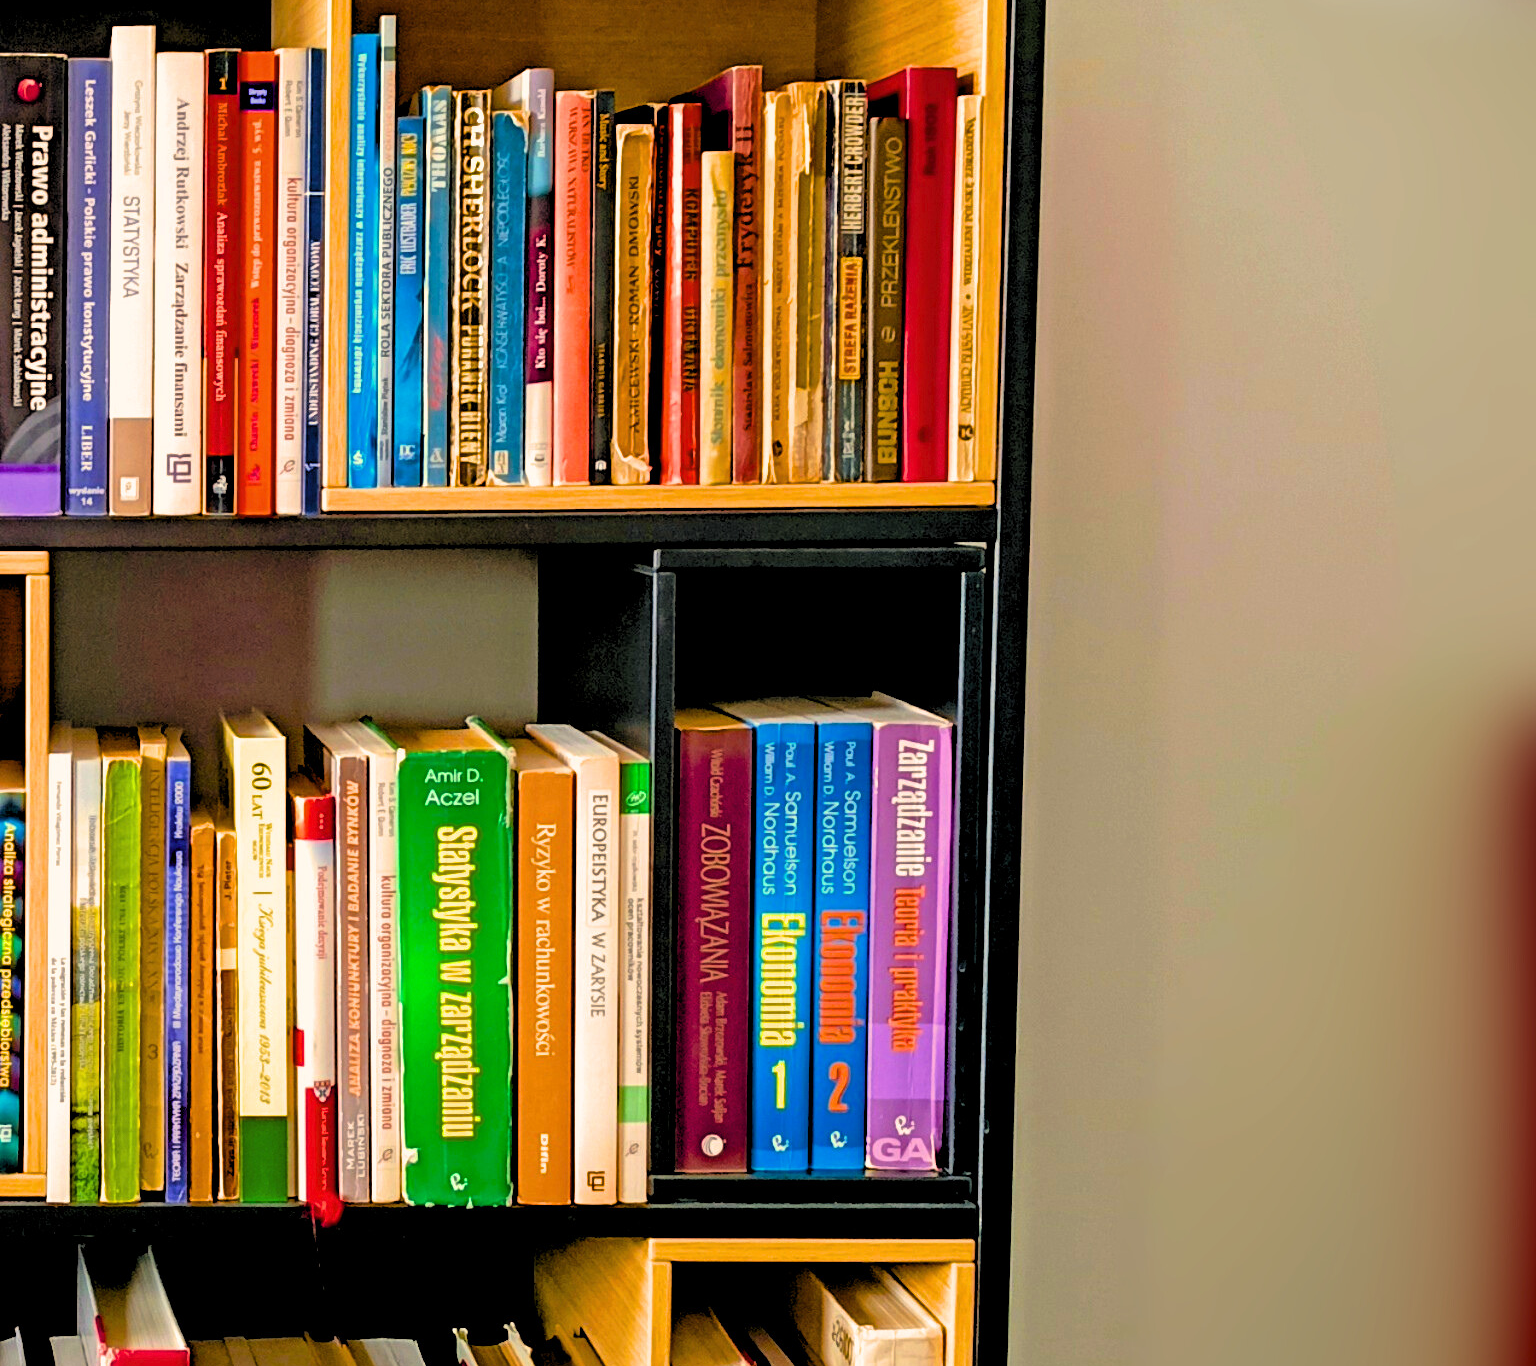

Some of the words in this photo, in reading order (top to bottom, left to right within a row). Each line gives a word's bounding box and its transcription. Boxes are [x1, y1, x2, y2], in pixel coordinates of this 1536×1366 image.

[84, 79, 97, 126] Leszek
[175, 98, 190, 162] Andrzej
[31, 125, 53, 207] Prawo
[84, 130, 96, 185] Garlicki
[431, 99, 447, 191] THOMAS
[84, 197, 96, 247] Polskie
[176, 166, 189, 249] Rutkowski
[81, 252, 94, 297] prawo
[123, 196, 140, 299] STATYSTYKA
[25, 213, 53, 411] administracyjne
[173, 263, 190, 357] Zarządzanie
[81, 301, 95, 402] konstytucyjne
[173, 361, 188, 437] finansami
[877, 359, 899, 464] BUNSCH
[81, 425, 92, 472] LIBER
[425, 768, 463, 783] Amir
[466, 769, 483, 783] D.
[763, 741, 775, 784] William
[785, 741, 796, 769] Paul
[785, 773, 795, 785] A.
[425, 788, 480, 806] Aczel
[764, 786, 774, 797] D.
[531, 823, 556, 892] Ryzyko
[591, 794, 609, 922] EUROPEISTYKA
[762, 801, 779, 895] Nordhaus
[784, 791, 801, 895] Samuelson
[432, 826, 478, 952] Statystyka
[535, 896, 551, 913] w
[695, 823, 731, 983] ZOBOWIĄZANIA
[439, 960, 470, 983] w
[592, 933, 606, 947] W
[535, 919, 555, 1057] rachunkowości
[590, 955, 606, 1017] ZARYSIE
[758, 911, 807, 1046] Ekonomia
[818, 910, 865, 1044] Ekonomia
[435, 990, 480, 1138] zarządzaniu
[772, 1060, 786, 1109] 1
[827, 1062, 849, 1112] 2
